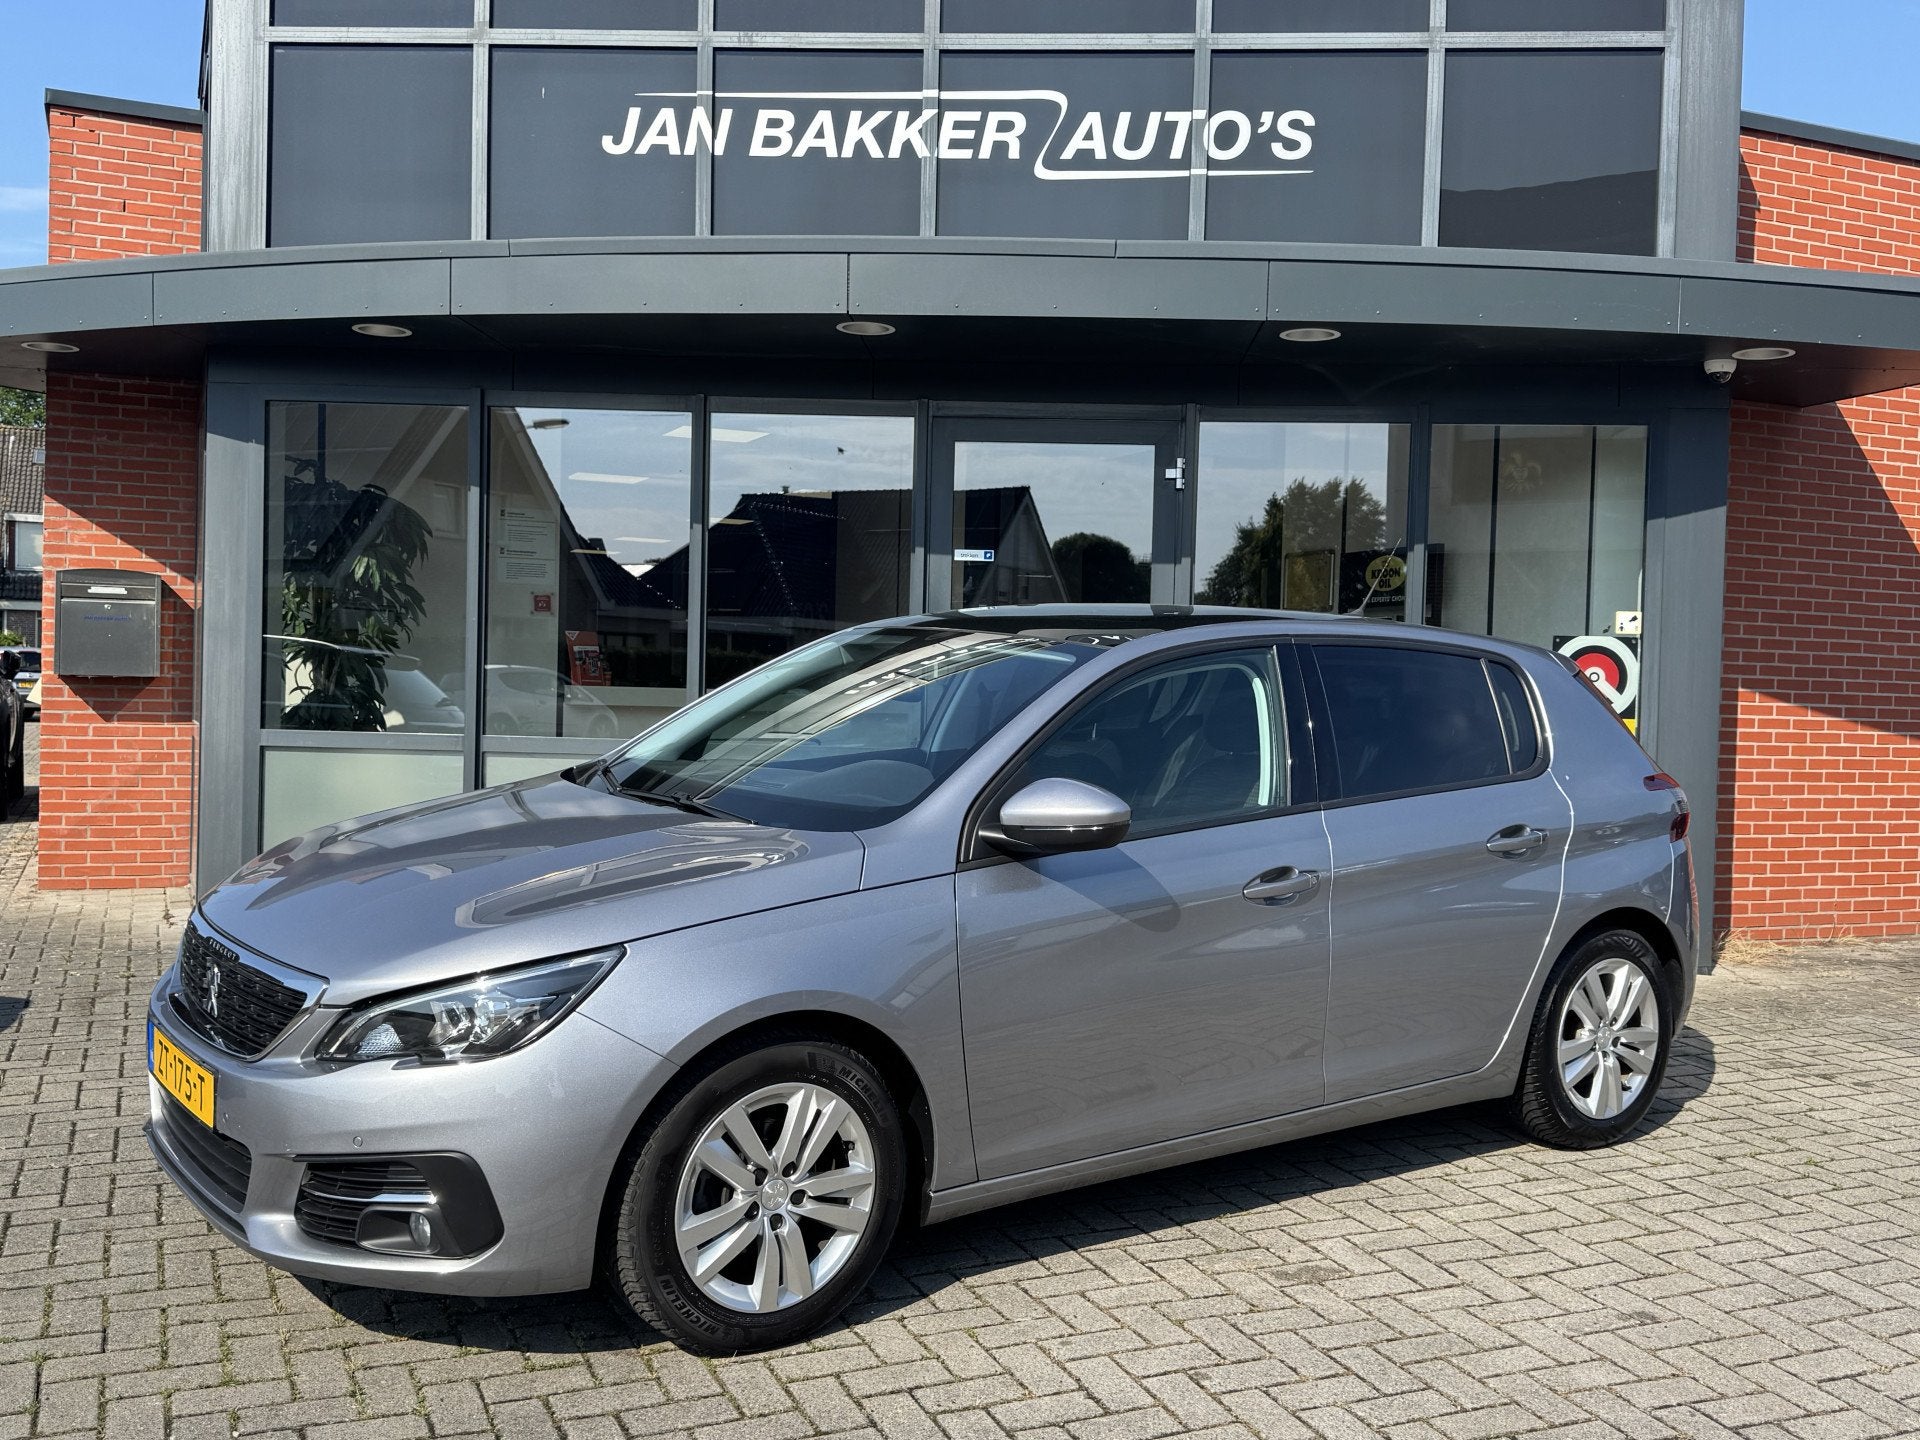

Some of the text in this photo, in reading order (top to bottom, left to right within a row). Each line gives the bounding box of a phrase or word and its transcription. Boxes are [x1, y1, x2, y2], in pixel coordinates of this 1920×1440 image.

[601, 107, 1316, 160] JAN BAKKER AUTO'S
[1379, 578, 1391, 588] OIL
[209, 938, 237, 961] PEUGEOT
[158, 1039, 205, 1113] ZT-175-T
[659, 1278, 720, 1335] MICHELIN
